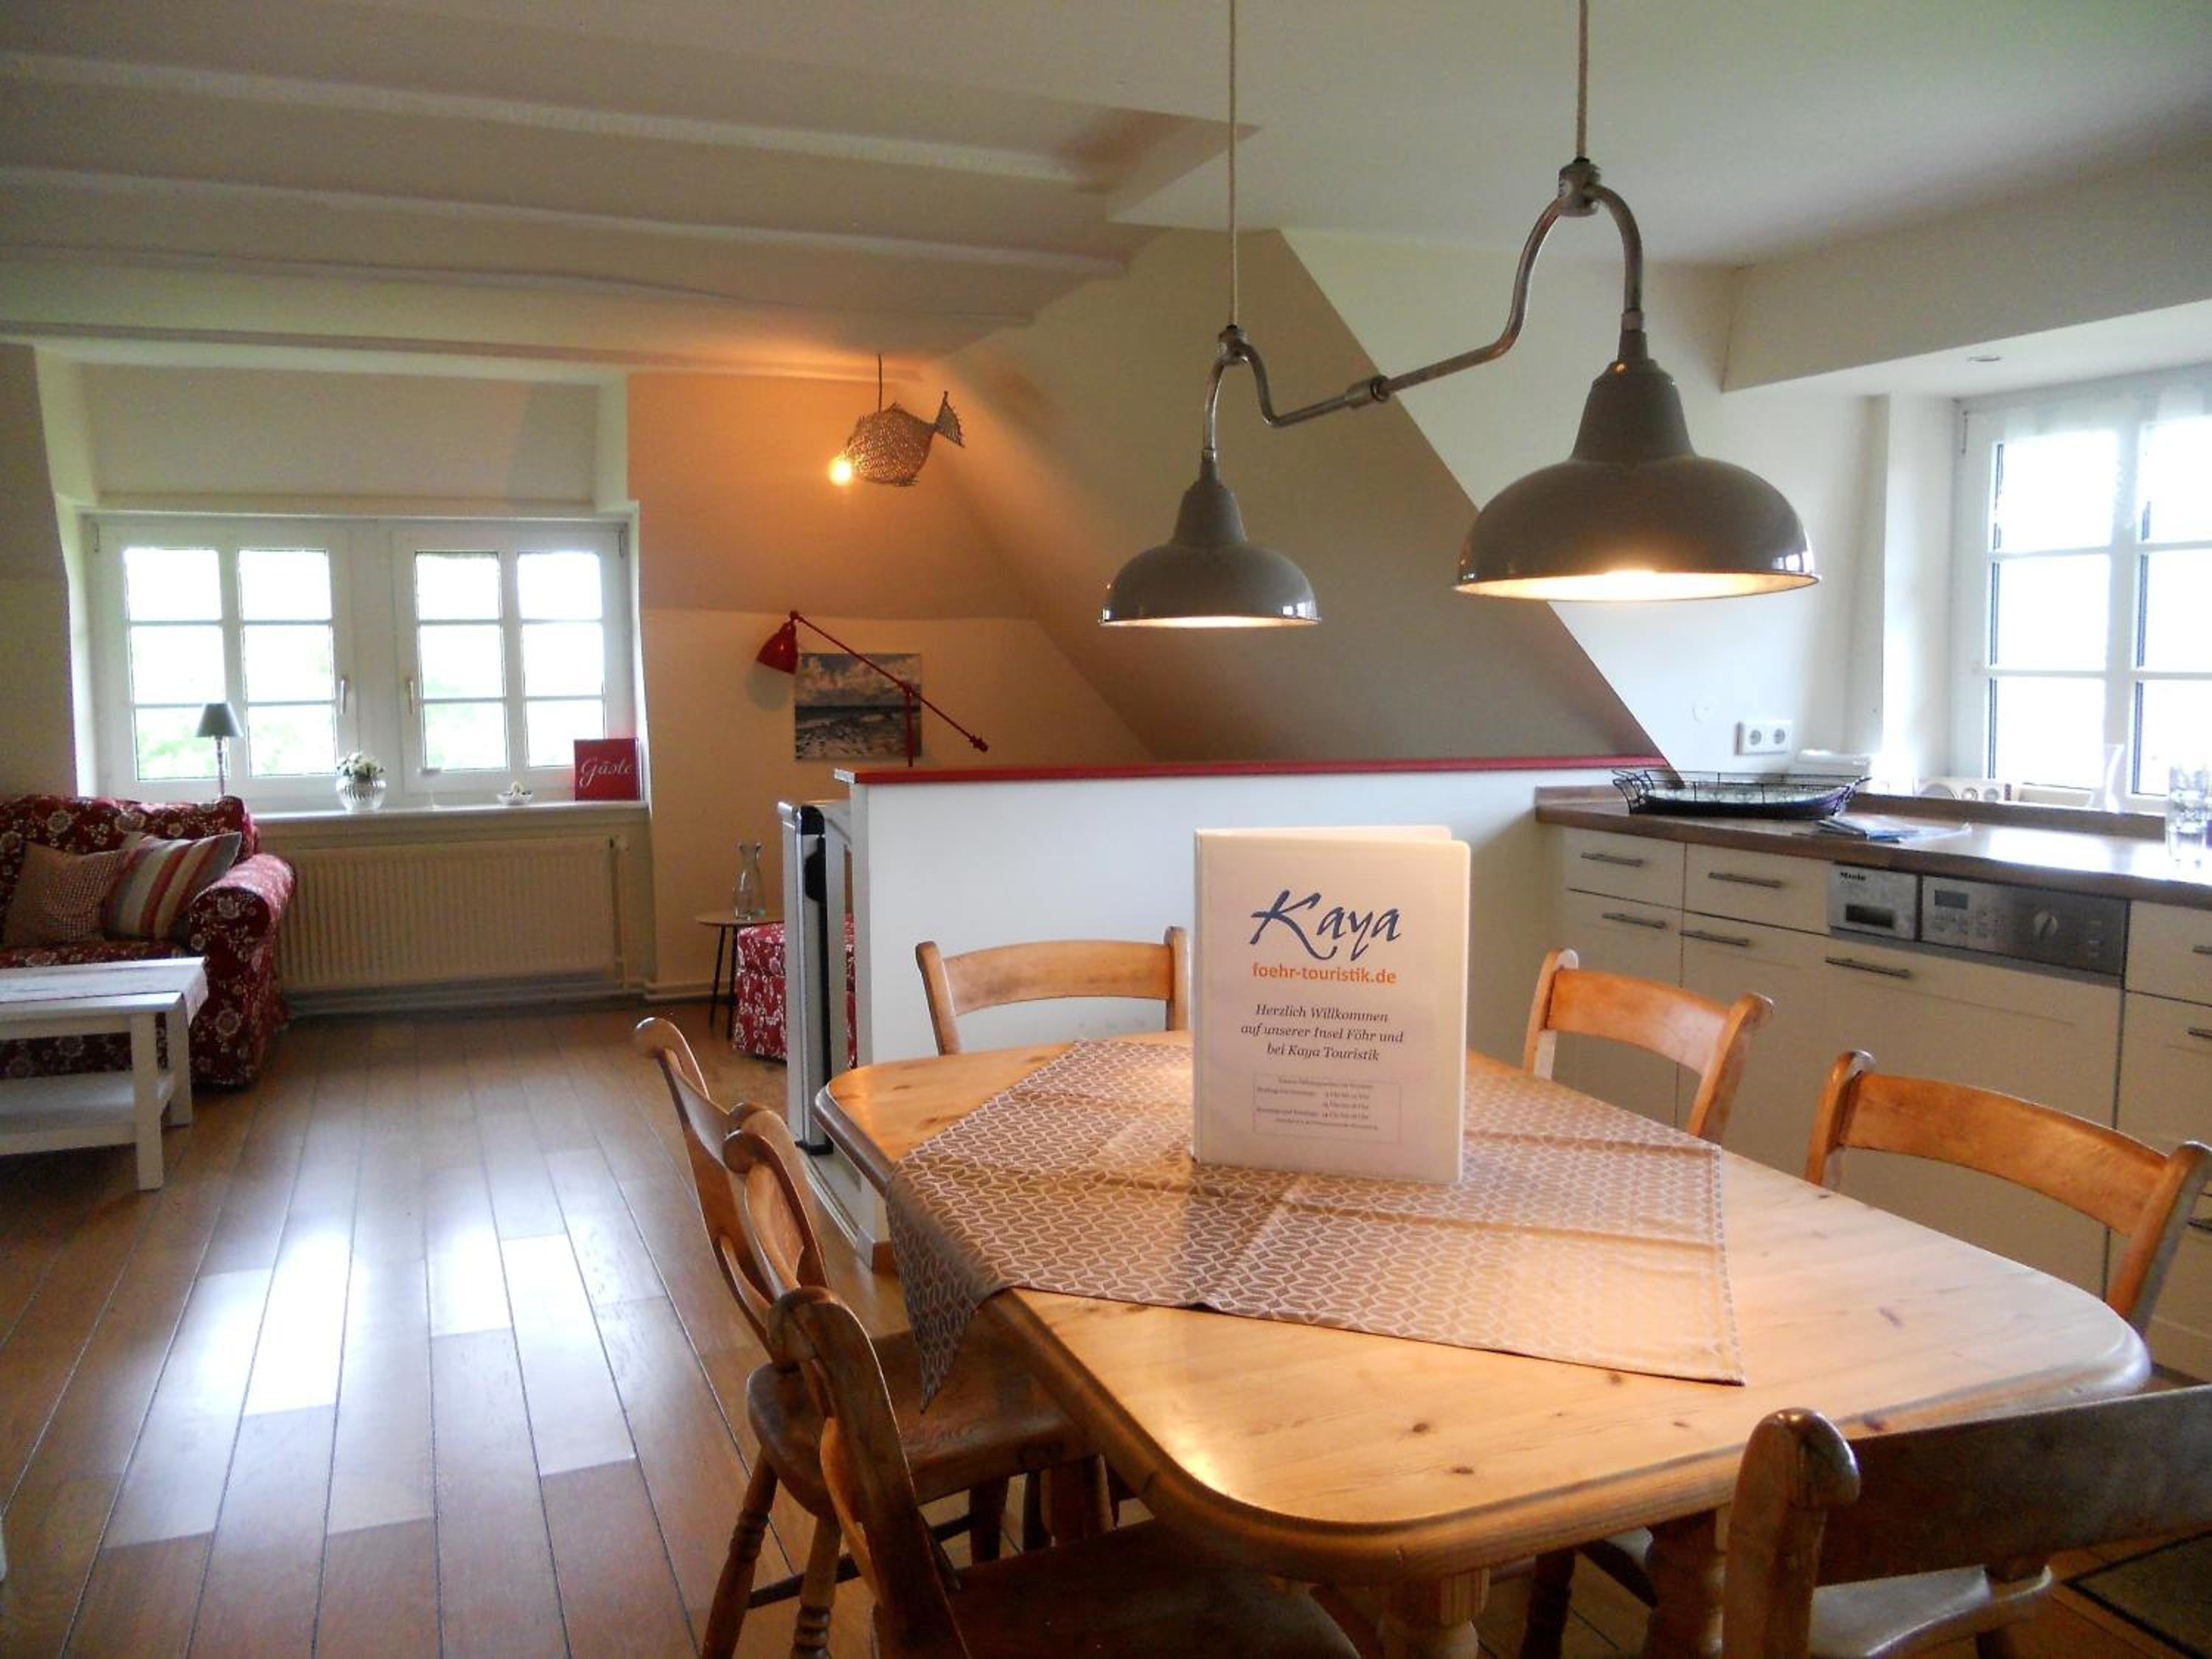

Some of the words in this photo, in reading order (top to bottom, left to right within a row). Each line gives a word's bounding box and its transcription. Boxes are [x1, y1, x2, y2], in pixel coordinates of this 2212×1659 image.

[1250, 890, 1401, 961] Kaya
[1253, 963, 1397, 984] foehr-touristik.de
[1255, 1004, 1307, 1018] Herzlich
[1311, 1006, 1388, 1023] Willkommen
[1240, 1023, 1262, 1037] auf
[1265, 1026, 1310, 1037] unserer
[1314, 1027, 1343, 1040] Insel
[1346, 1028, 1377, 1040] Föhr
[1380, 1032, 1404, 1043] und
[1266, 1043, 1284, 1056] bei
[1287, 1045, 1321, 1059] Kaya
[1324, 1046, 1380, 1062] Touristik
